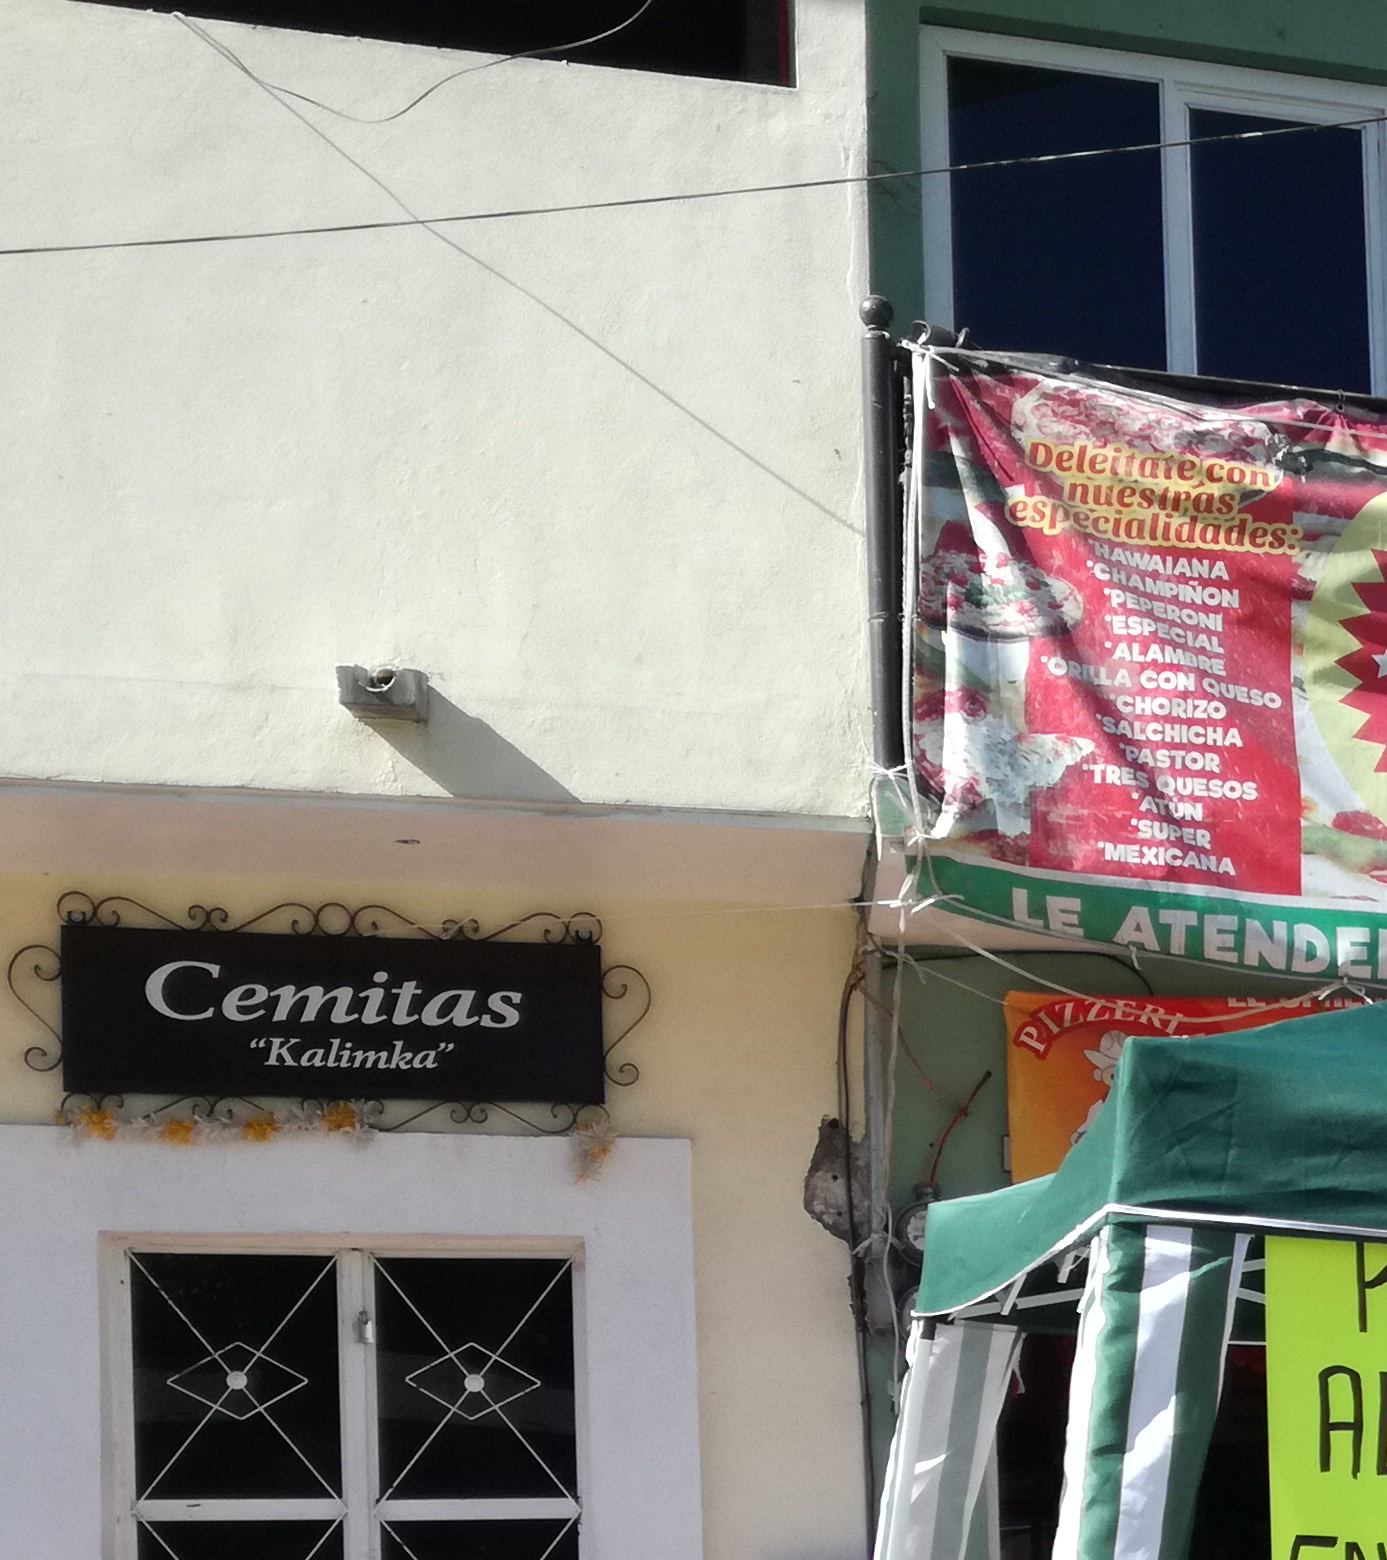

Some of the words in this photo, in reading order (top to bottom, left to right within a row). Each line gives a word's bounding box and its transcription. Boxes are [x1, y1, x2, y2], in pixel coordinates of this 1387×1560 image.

[1029, 441, 1197, 482] Deleitate
[1206, 461, 1273, 487] con
[1066, 481, 1236, 516] nuestras
[1009, 498, 1301, 550] especialidades:
[1095, 543, 1229, 581] HAWAIANA
[1094, 563, 1239, 608] CHAMPIÑON
[1111, 590, 1223, 632] PEPERONI
[1111, 616, 1224, 654] ESPECIAL
[1111, 643, 1225, 676] ALAMBRE
[1047, 657, 1131, 688] ORILLA
[1140, 669, 1195, 692] CON
[1202, 678, 1282, 710] QUESO
[1116, 696, 1227, 719] CHORIZO
[1102, 717, 1243, 747] SALCHICHA
[1126, 745, 1220, 773] PASTOR
[1089, 765, 1150, 787] TRES
[1157, 773, 1258, 800] QUESOS
[1137, 820, 1211, 848] SUPER
[1104, 844, 1236, 877] MEXICANA
[1012, 888, 1084, 938] LE
[144, 960, 523, 1029] Cemitas
[1019, 999, 1190, 1056] PIZZERI
[248, 1036, 454, 1071] “Kalimka”
